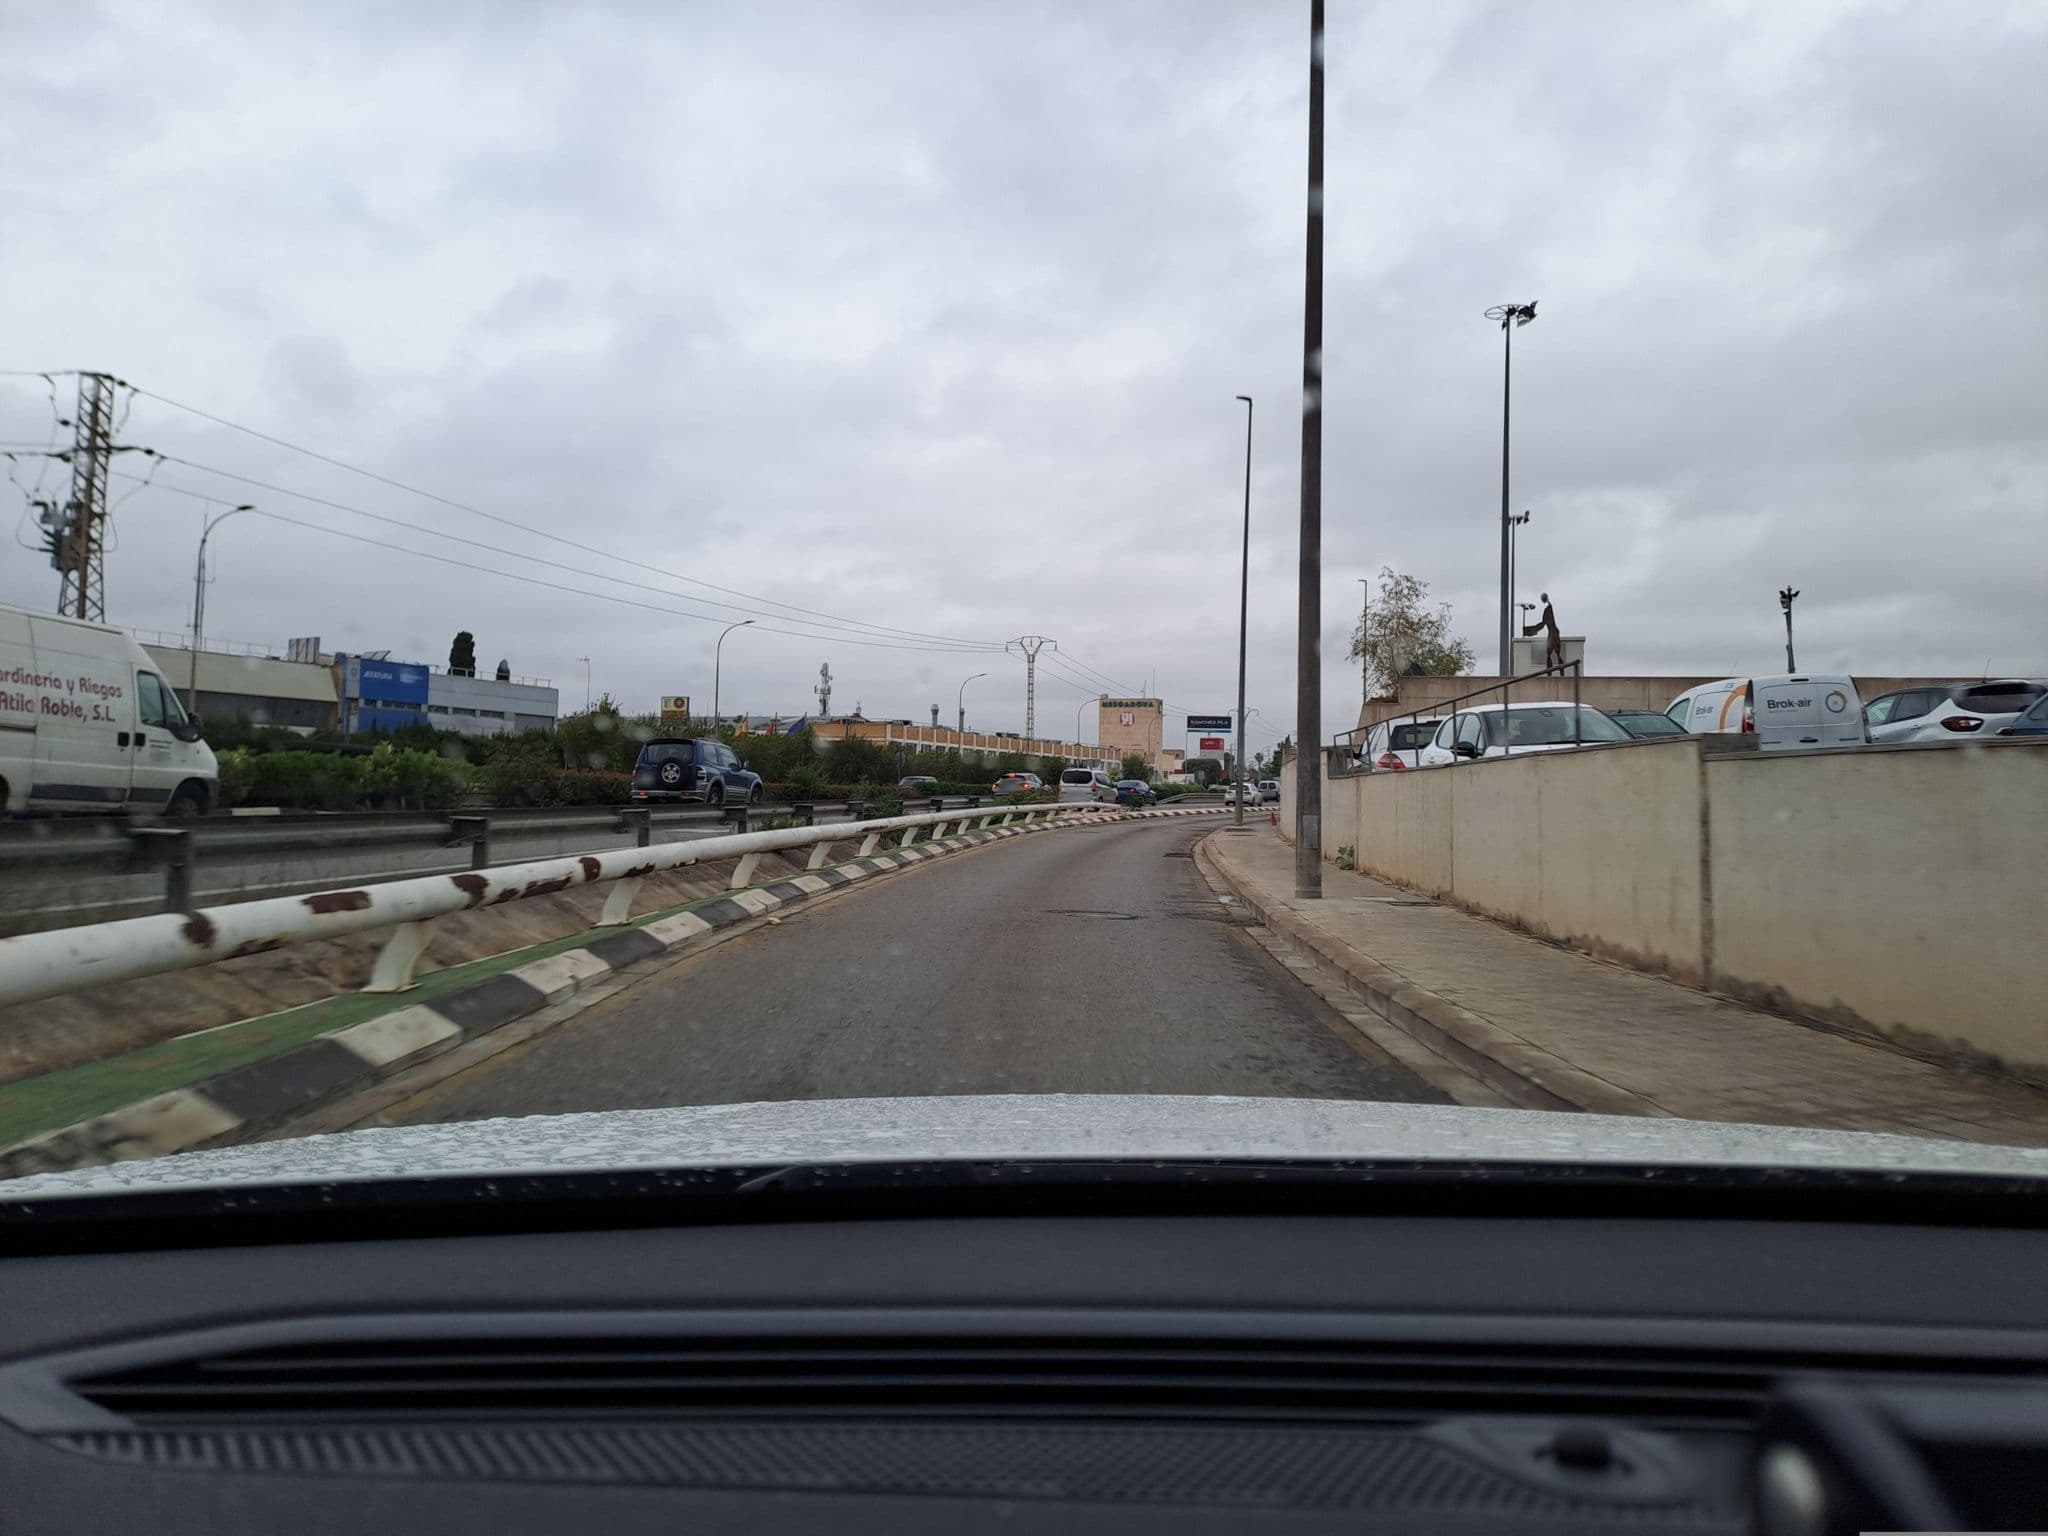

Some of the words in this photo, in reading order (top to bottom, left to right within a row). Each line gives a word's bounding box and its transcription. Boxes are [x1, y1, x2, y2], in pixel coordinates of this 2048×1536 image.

[66, 679, 75, 696] y
[79, 677, 123, 700] Riegos
[41, 696, 87, 723] Roble,
[92, 704, 116, 722] S.L.
[1767, 697, 1812, 709] Brok-air
